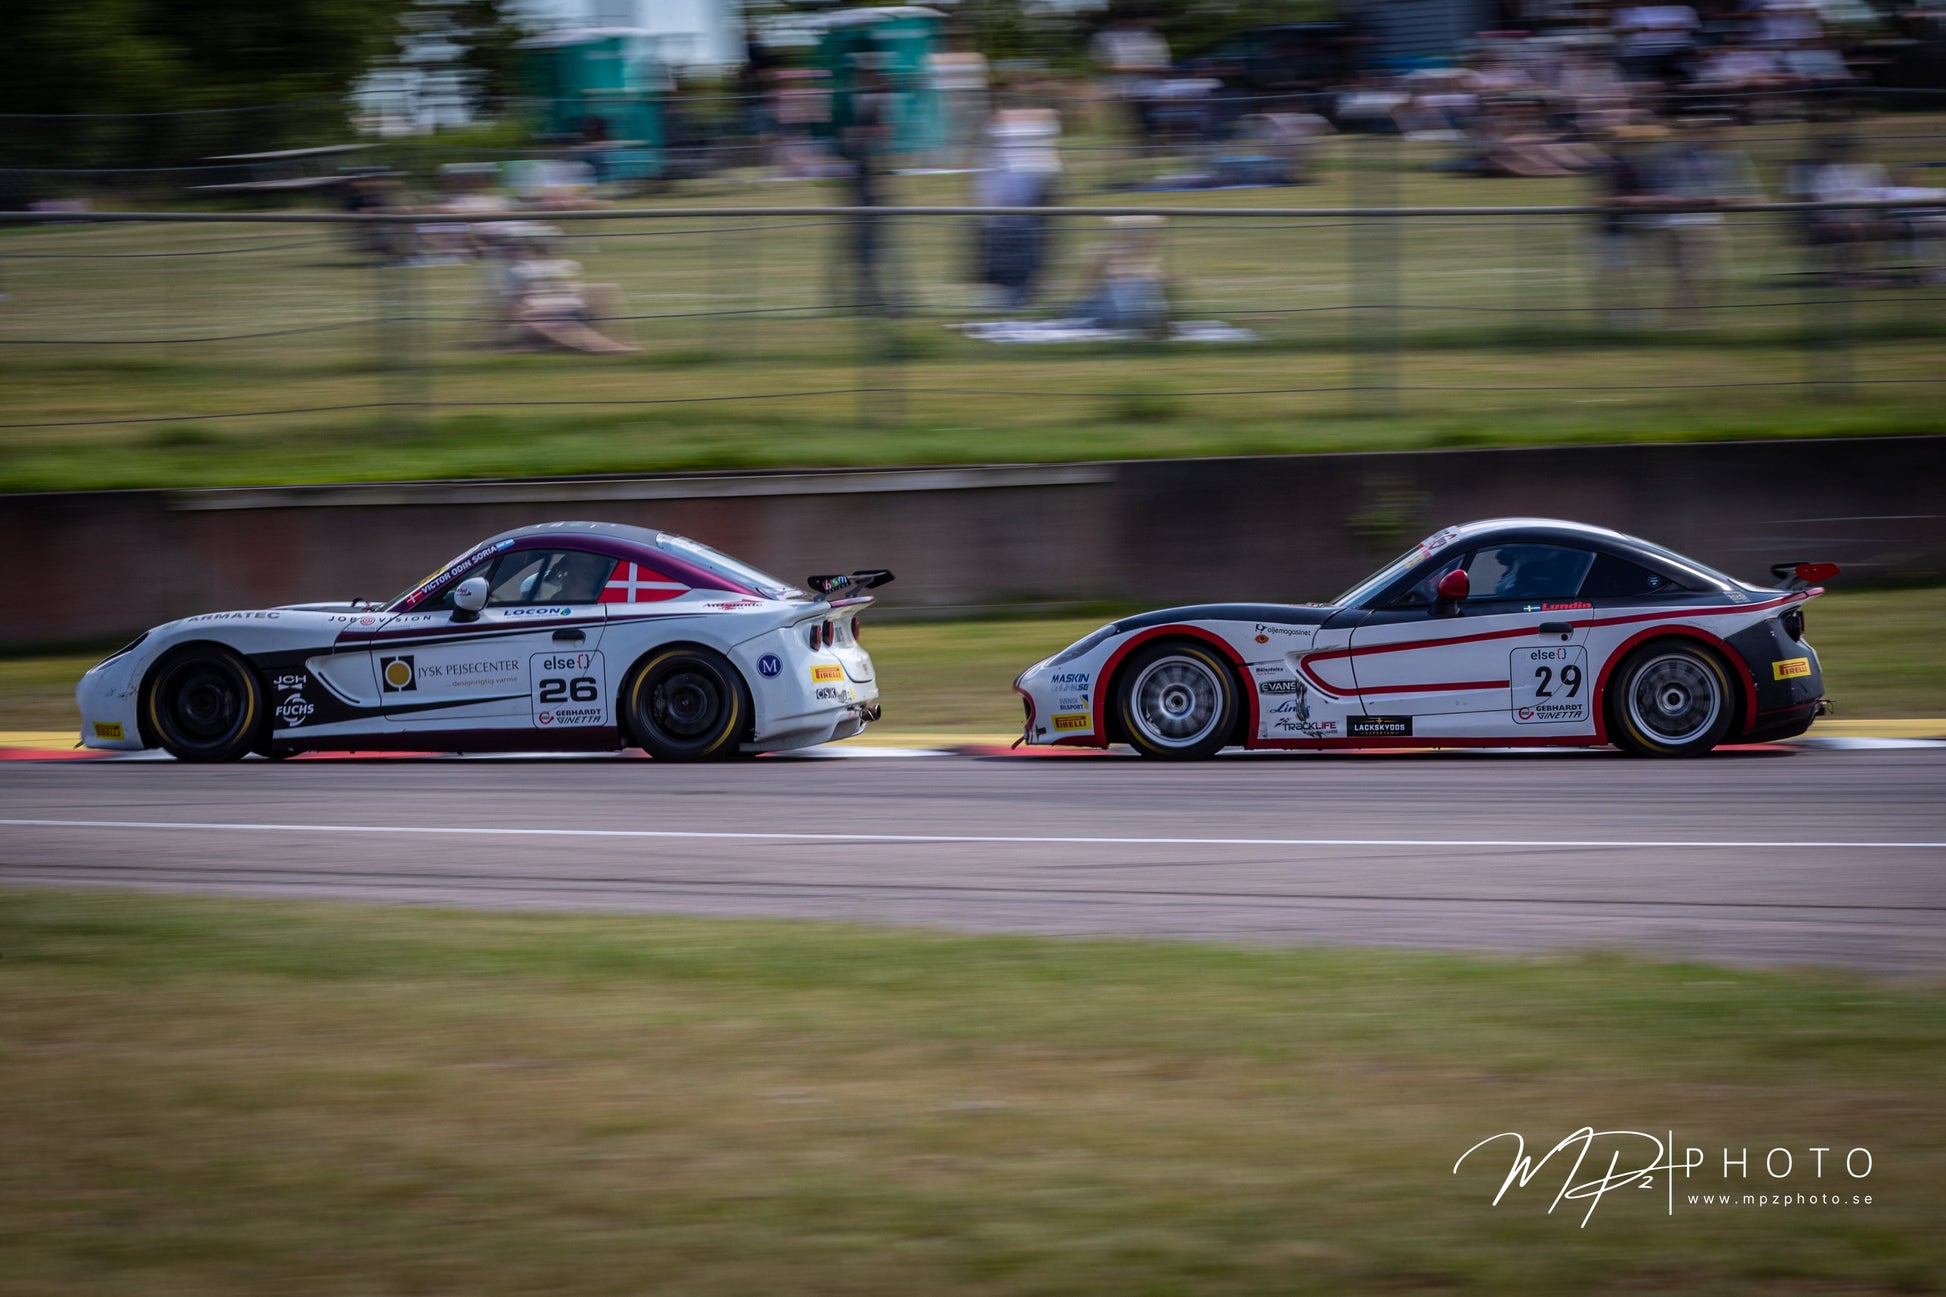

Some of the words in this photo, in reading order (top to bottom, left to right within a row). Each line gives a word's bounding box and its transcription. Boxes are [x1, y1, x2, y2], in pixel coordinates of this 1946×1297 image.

[421, 572, 452, 594] VICTOR
[451, 560, 472, 576] ODIN
[471, 545, 498, 564] SORIA
[1541, 602, 1592, 611] Lundin
[504, 608, 561, 616] LOCON
[187, 612, 281, 623] ARMATEC
[1267, 626, 1311, 636] oljemagasinet
[418, 665, 443, 679] JYSK
[446, 660, 520, 676] PEJSECENTER
[815, 667, 841, 680] PIRELLI
[1778, 661, 1807, 676] PIRELLI
[1051, 673, 1090, 683] MASKIN
[1535, 664, 1582, 698] 29
[539, 677, 598, 703] 26
[1261, 682, 1297, 691] EVANS
[275, 704, 314, 717] FUCHS
[555, 708, 602, 717] GEBHARDT
[1536, 711, 1583, 720] GINETTA
[556, 716, 602, 724] GINETTA
[1055, 716, 1087, 728] PIRELLI
[1354, 724, 1405, 732] LACKSKYDDS
